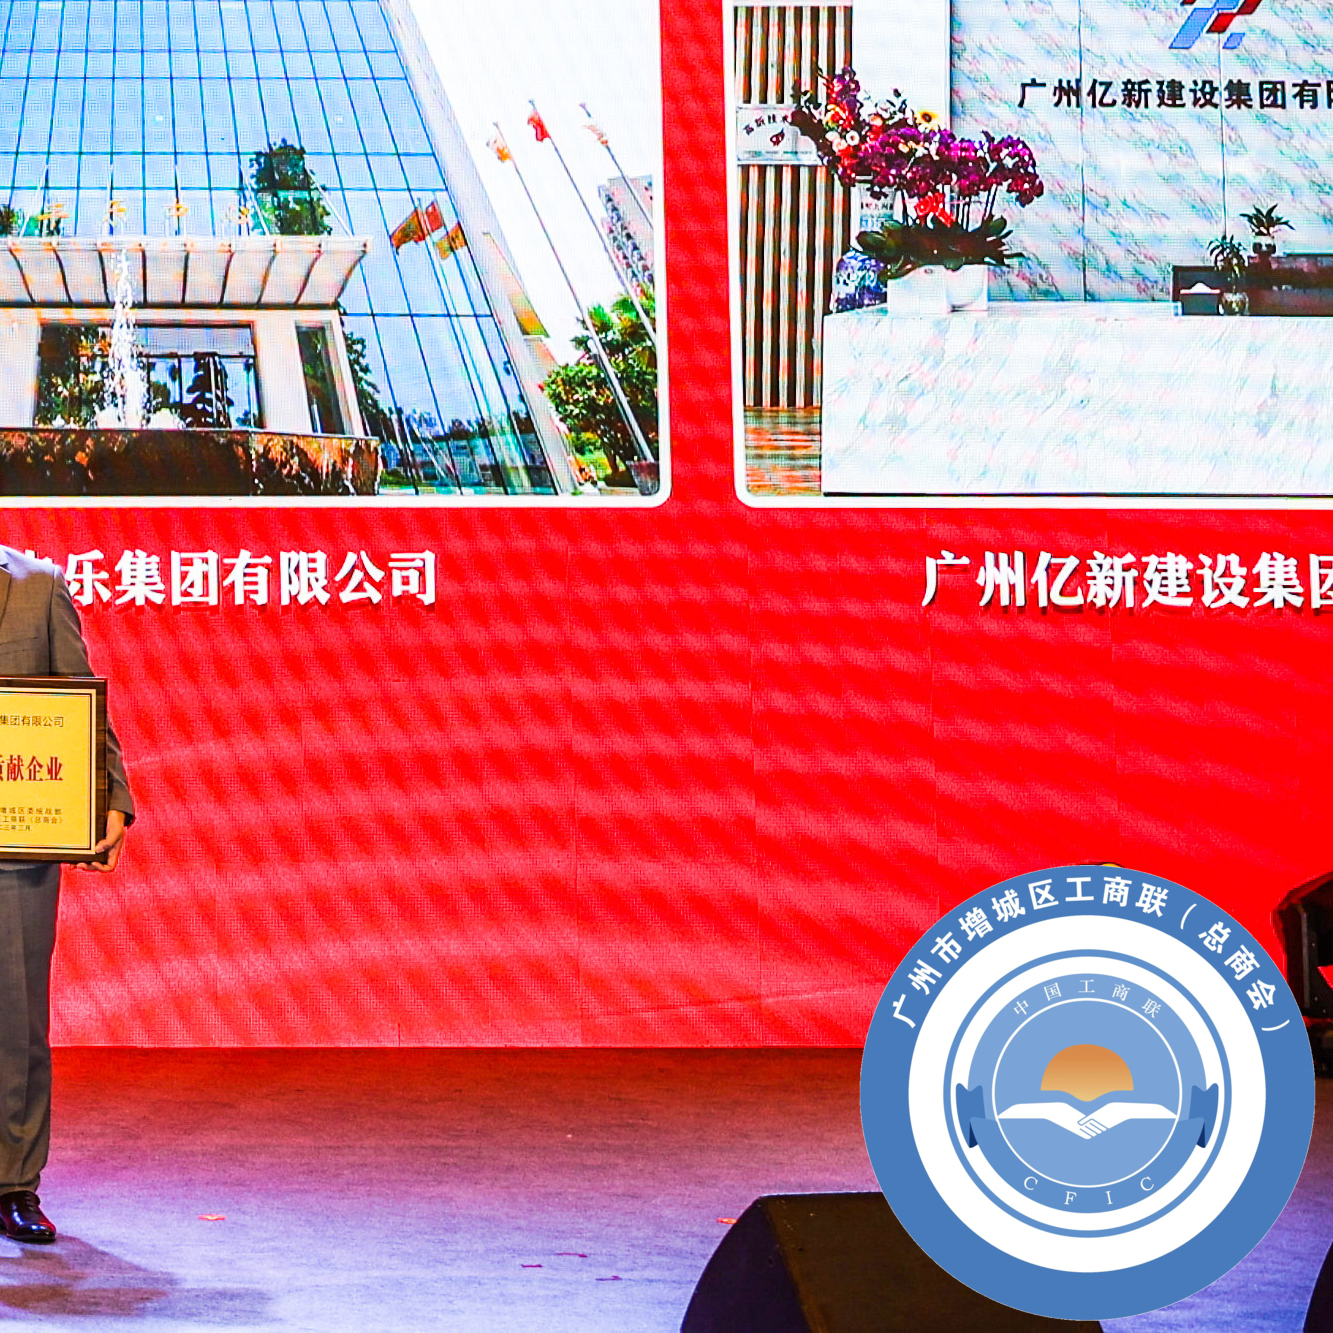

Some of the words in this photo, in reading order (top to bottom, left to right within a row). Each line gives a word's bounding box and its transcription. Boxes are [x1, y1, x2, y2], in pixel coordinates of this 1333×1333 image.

[1018, 78, 1333, 110] 广州亿新建设集团有
[23, 549, 437, 607] 乐集团有限公司
